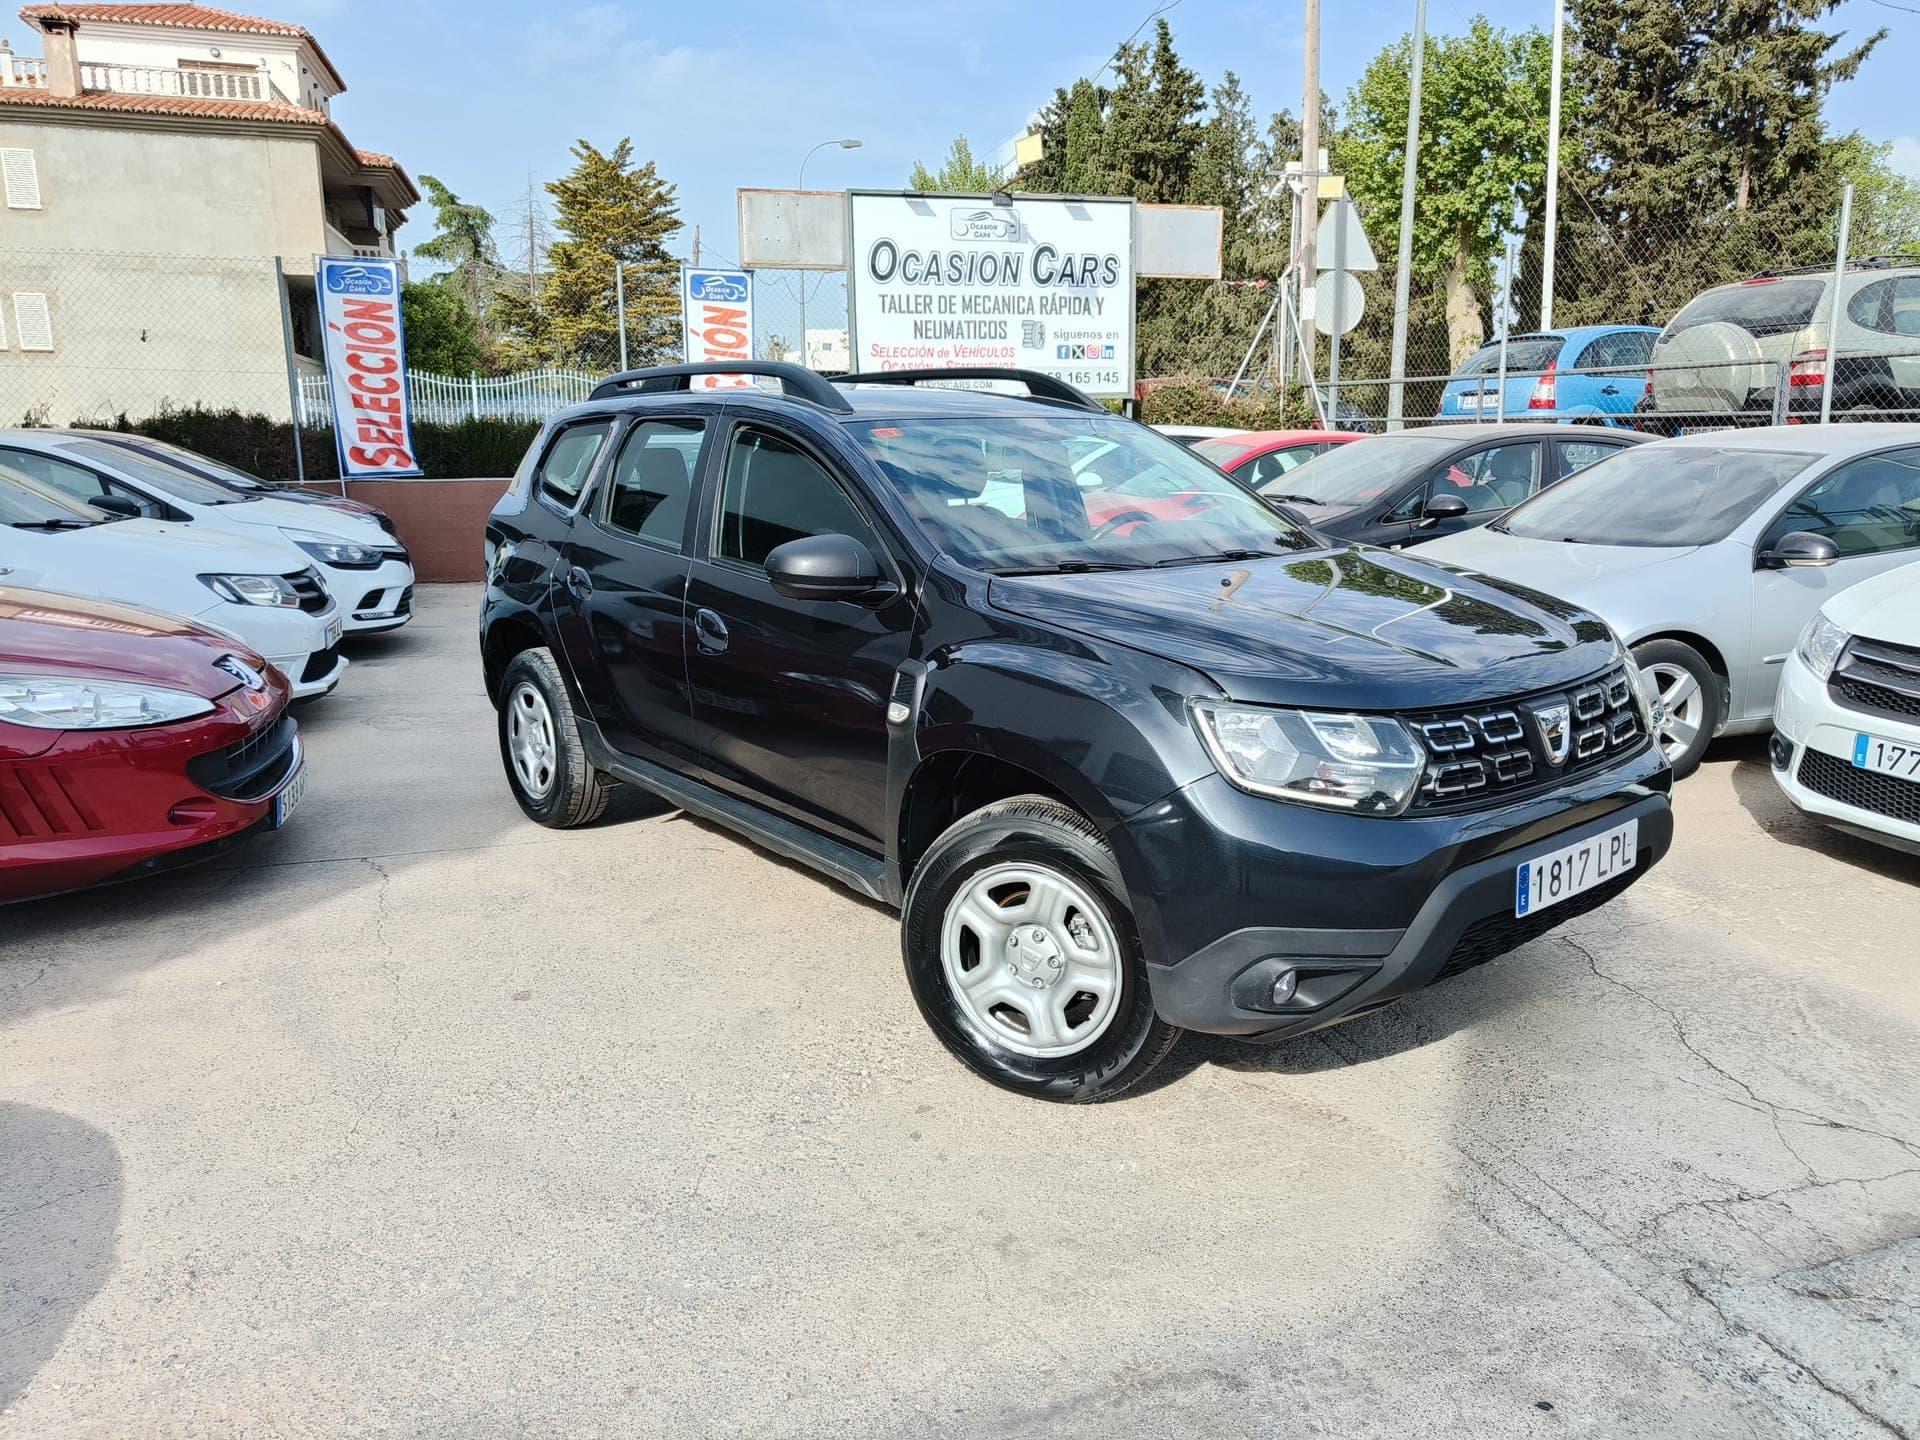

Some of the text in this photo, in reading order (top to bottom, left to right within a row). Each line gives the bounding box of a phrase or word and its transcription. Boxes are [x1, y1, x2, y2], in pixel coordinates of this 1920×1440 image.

[870, 239, 1120, 287] OCASION CARS
[879, 293, 1104, 316] TALLER DE MECANICA RÁPIDA Y
[914, 320, 1008, 340] NEUMATICOS
[870, 344, 1016, 358] SELECCIÓN de VEHÍCULOS
[328, 298, 412, 468] SELECCIÓN
[1068, 372, 1091, 384] 165
[1096, 372, 1119, 384] 145
[1537, 832, 1631, 902] 1817 LPL
